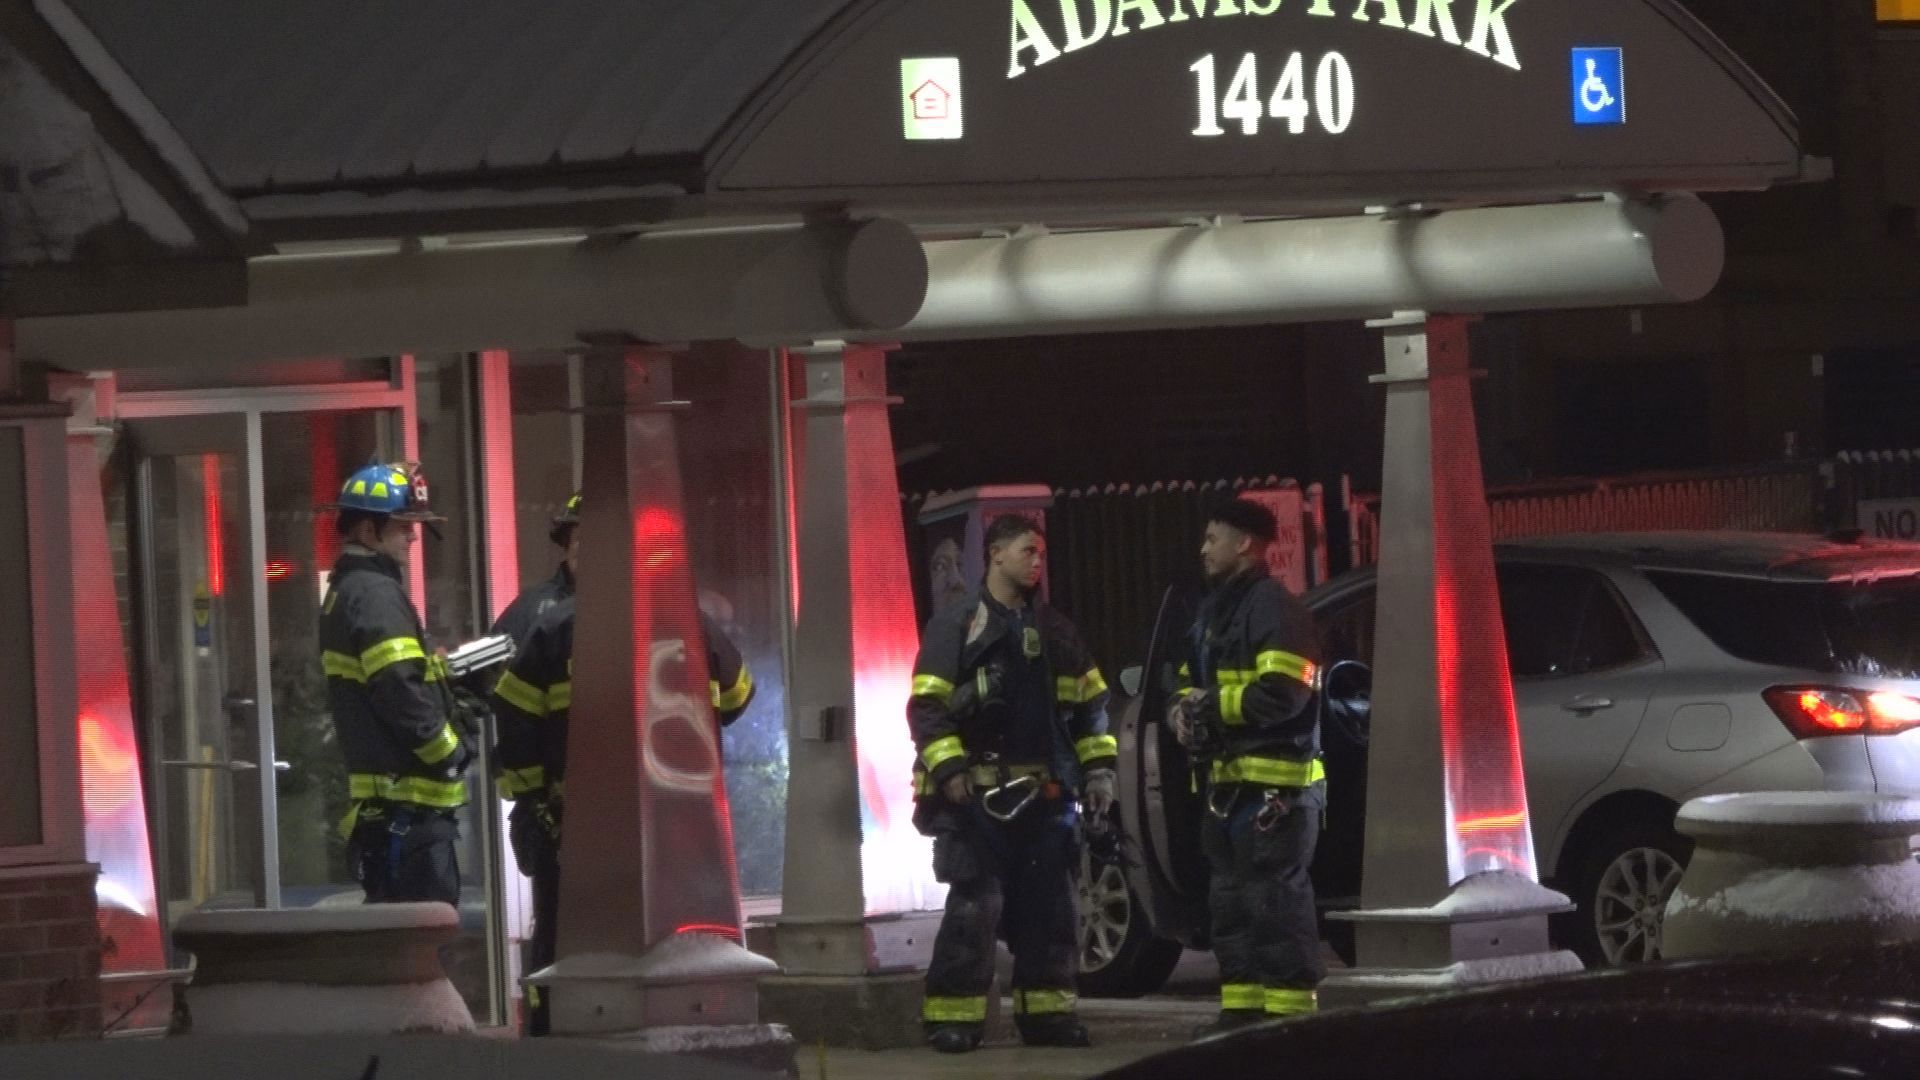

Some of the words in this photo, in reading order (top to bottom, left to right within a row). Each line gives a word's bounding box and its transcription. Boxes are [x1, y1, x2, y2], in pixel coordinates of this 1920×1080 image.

[1006, 0, 1283, 79] ADA
[1306, 0, 1522, 71] RK
[1189, 51, 1355, 136] 1440
[1874, 508, 1916, 539] NO
